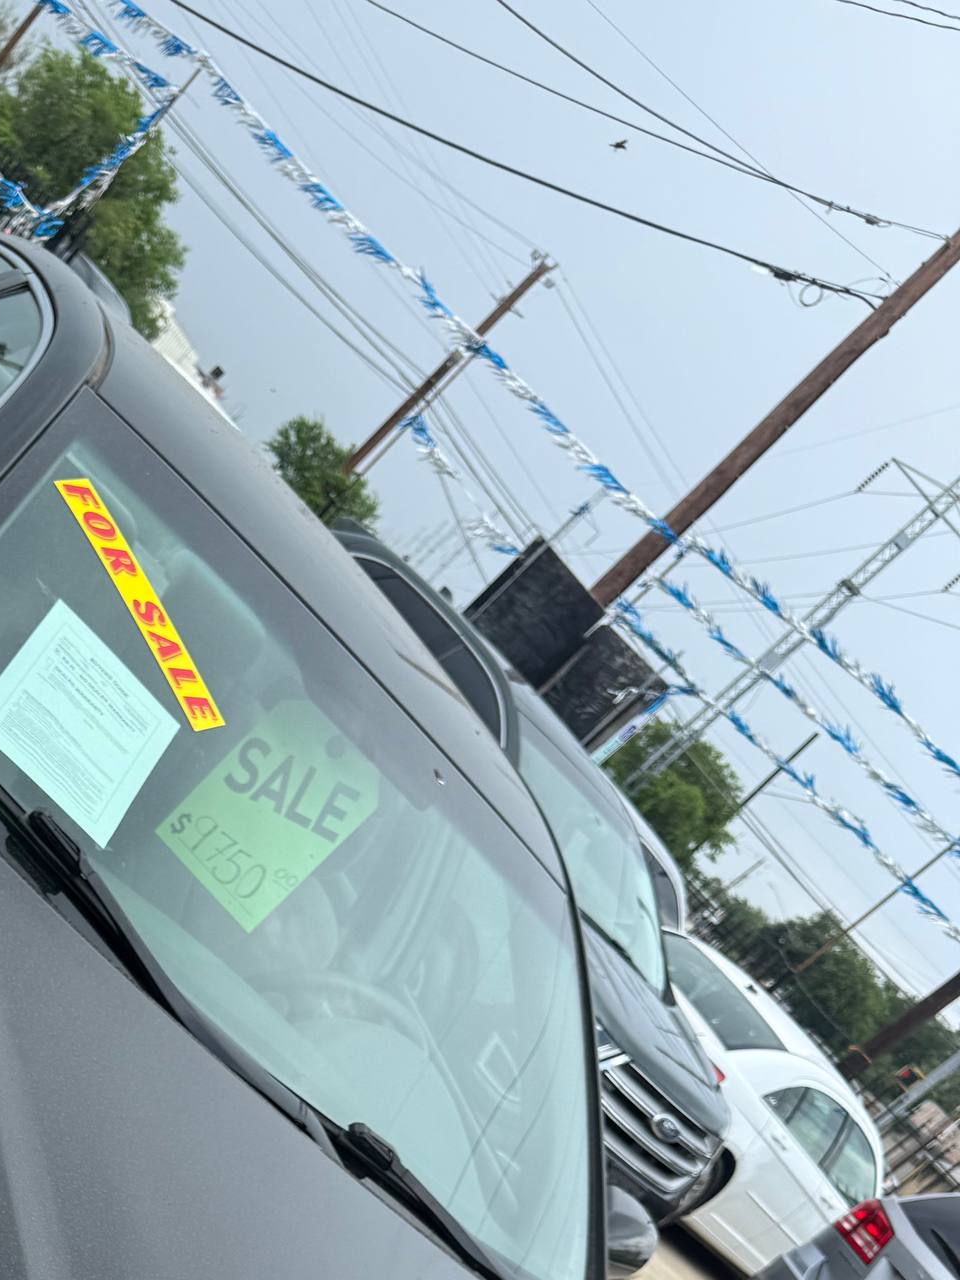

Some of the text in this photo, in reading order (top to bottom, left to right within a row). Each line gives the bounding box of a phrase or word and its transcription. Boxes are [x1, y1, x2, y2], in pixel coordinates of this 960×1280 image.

[62, 483, 217, 722] FOR SALE
[223, 736, 361, 844] SALE
